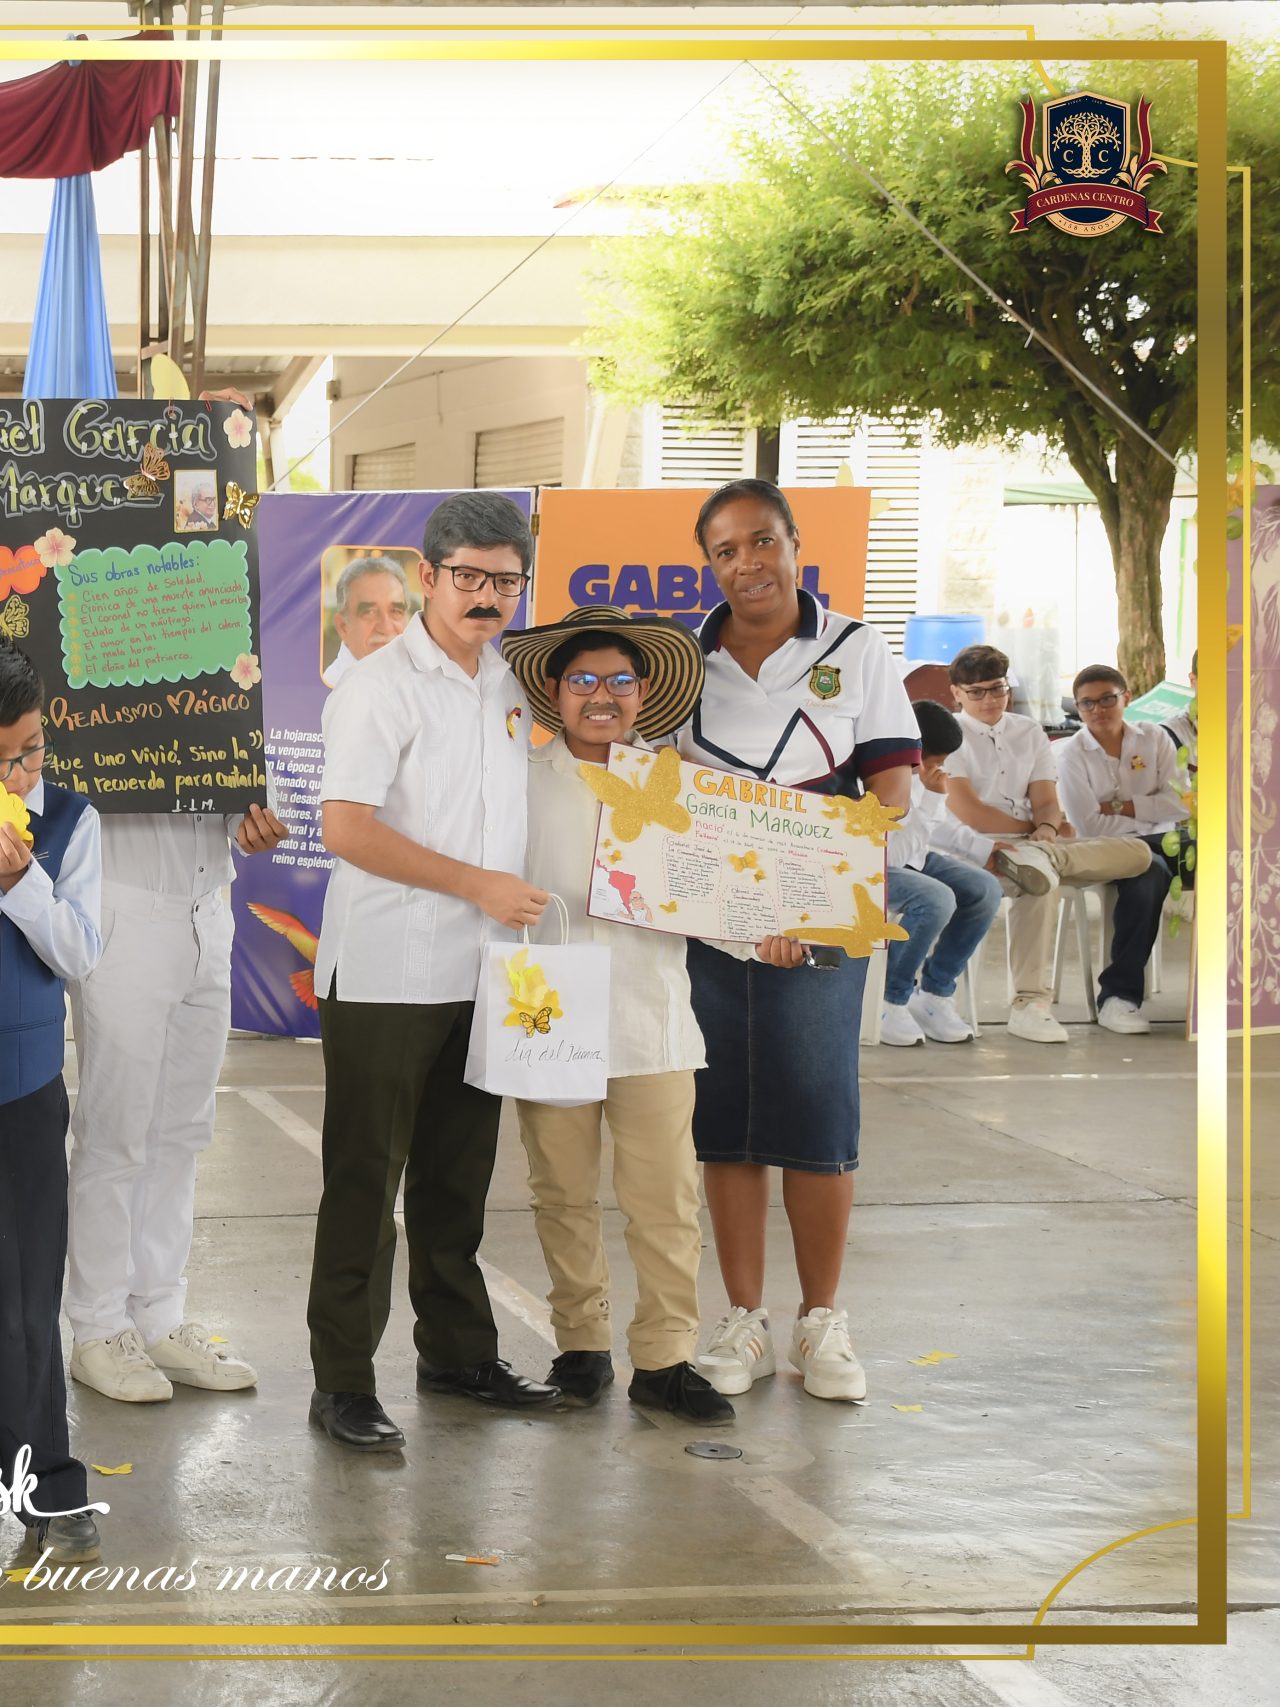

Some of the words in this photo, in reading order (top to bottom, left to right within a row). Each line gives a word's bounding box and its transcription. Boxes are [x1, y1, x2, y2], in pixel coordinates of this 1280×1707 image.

[68, 563, 98, 587] Sus
[105, 562, 140, 581] obras
[147, 553, 200, 576] notables:
[83, 590, 109, 603] Cien
[147, 582, 159, 591] de
[126, 597, 137, 608] de
[81, 614, 93, 625] El
[98, 609, 132, 622] coronel
[137, 609, 149, 617] no
[152, 604, 177, 616] tiene
[83, 626, 114, 638] Relato
[121, 622, 131, 633] de
[84, 640, 95, 650] El
[85, 664, 97, 674] El
[270, 728, 281, 739] La
[284, 728, 323, 743] hojarasc
[264, 744, 275, 754] da
[278, 746, 321, 759] venganza
[94, 751, 126, 768] uno
[276, 760, 285, 771] la
[287, 760, 315, 774] época
[94, 770, 165, 794] recuerda
[175, 772, 213, 795] para
[273, 775, 307, 789] denado
[308, 779, 321, 792] qu
[290, 792, 321, 805] desast
[693, 769, 807, 814] GABRIEL
[277, 806, 313, 820] jadores.
[287, 823, 308, 835] tural
[308, 827, 315, 838] y
[276, 839, 299, 850] elato
[300, 841, 307, 851] a
[271, 853, 296, 865] reino
[297, 856, 336, 869] espléndi
